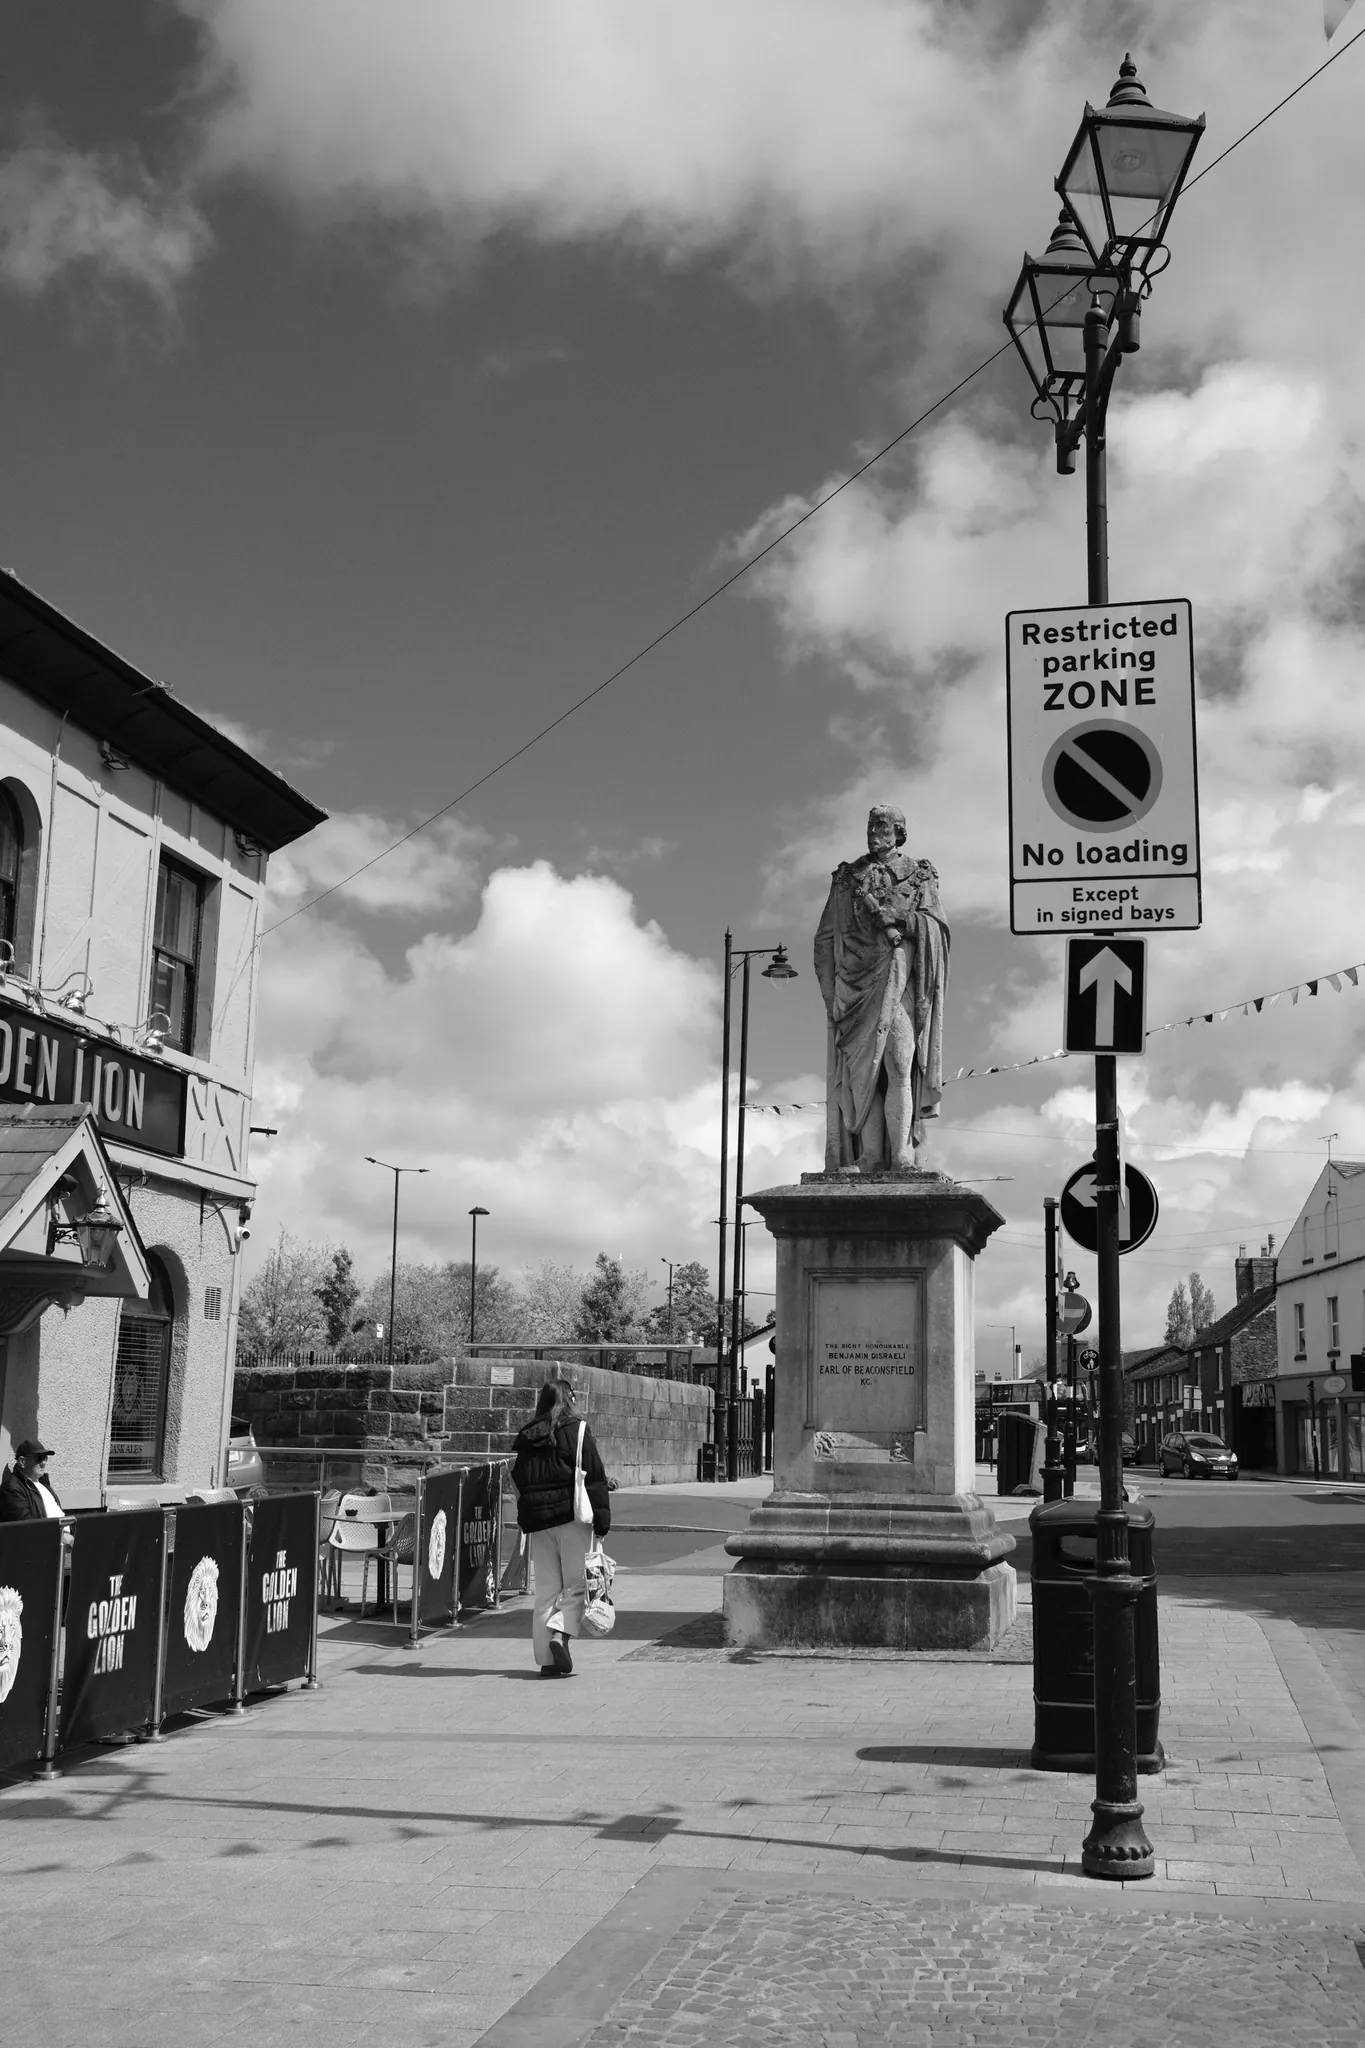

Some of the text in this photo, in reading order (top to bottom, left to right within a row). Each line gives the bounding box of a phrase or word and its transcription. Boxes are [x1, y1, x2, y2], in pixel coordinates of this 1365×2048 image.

[1022, 614, 1177, 645] Restricted
[1043, 647, 1156, 677] parking
[1043, 677, 1156, 711] ZONE
[1022, 839, 1188, 866] No loading
[1072, 886, 1139, 904] Except
[1037, 903, 1175, 924] in signed bays
[73, 1048, 145, 1130] LION
[819, 1365, 915, 1375] EARL OF BEACONSFIELD
[828, 1352, 906, 1360] BENJAMIN DISRAELI
[275, 1550, 287, 1569] THE
[109, 1574, 124, 1597] THE
[262, 1567, 298, 1604] GOLDEN
[87, 1595, 137, 1639] GOLDEN
[267, 1600, 289, 1634] LION
[93, 1634, 124, 1675] LION
